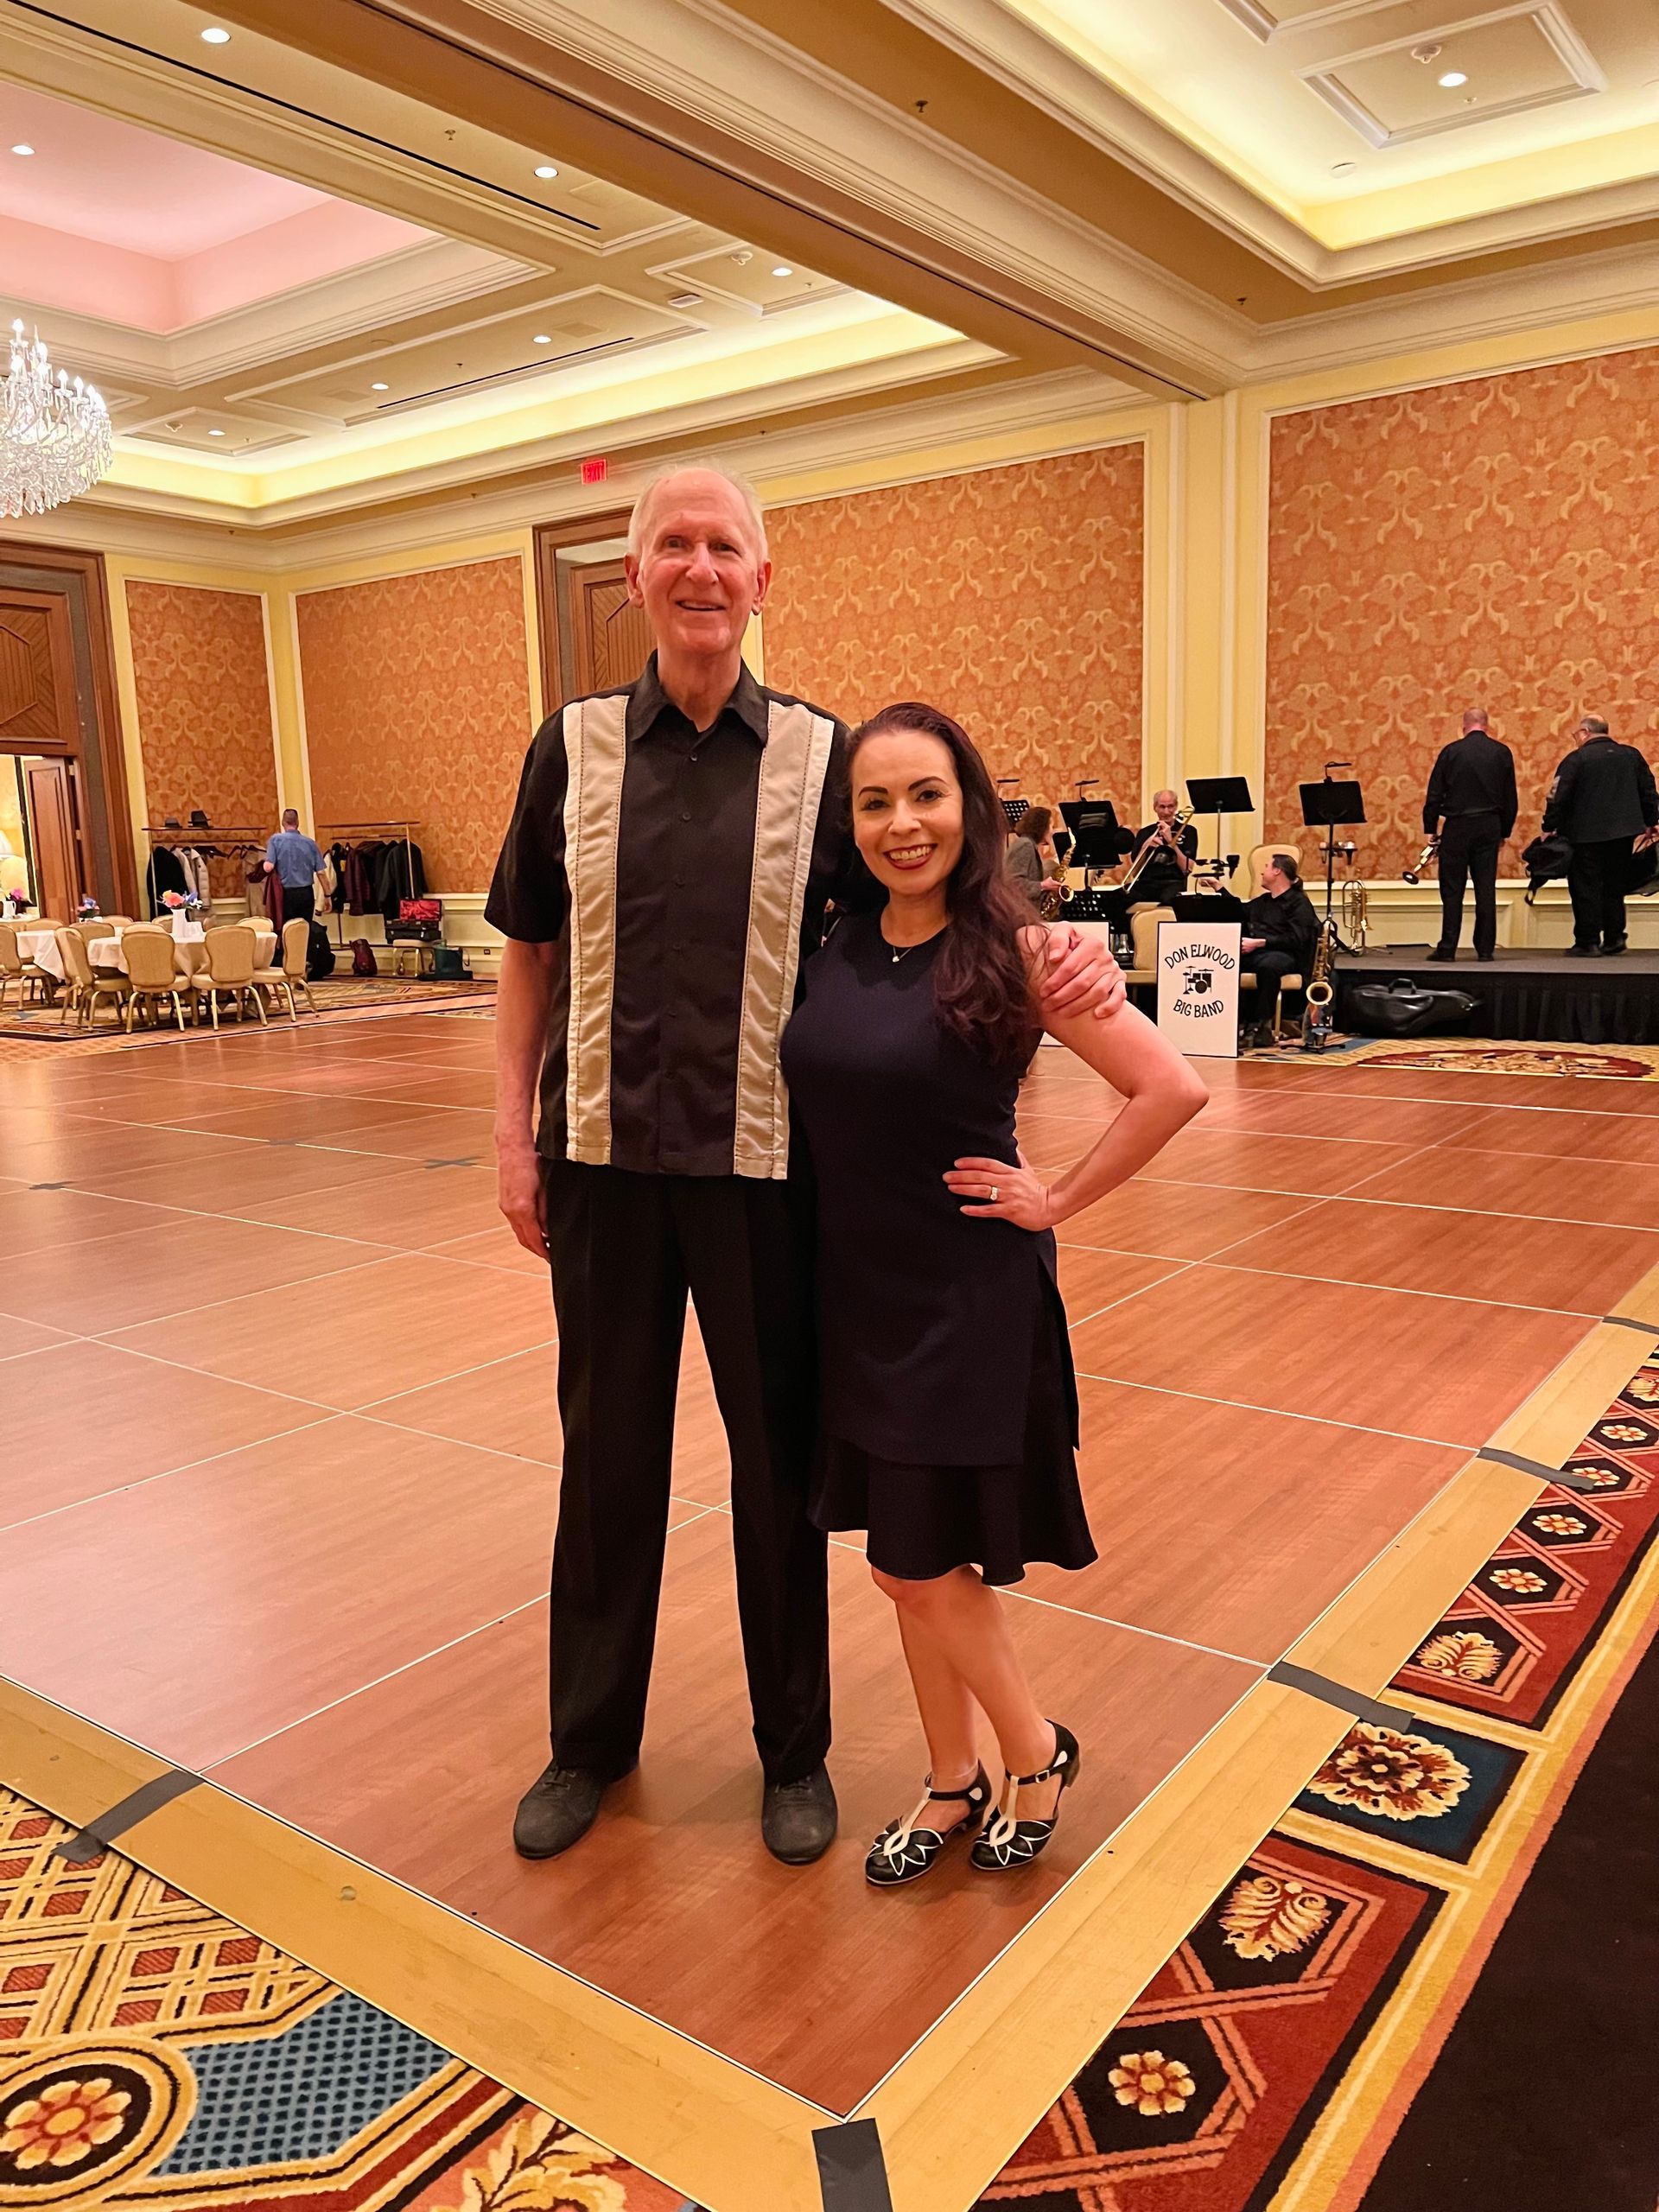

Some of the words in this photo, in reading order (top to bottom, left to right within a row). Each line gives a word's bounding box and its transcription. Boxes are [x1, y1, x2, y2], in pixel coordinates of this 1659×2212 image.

[1165, 946, 1189, 969] DON
[1191, 944, 1236, 970] ELWOOD
[1173, 999, 1192, 1016] BIG
[1194, 1000, 1224, 1018] BAND
